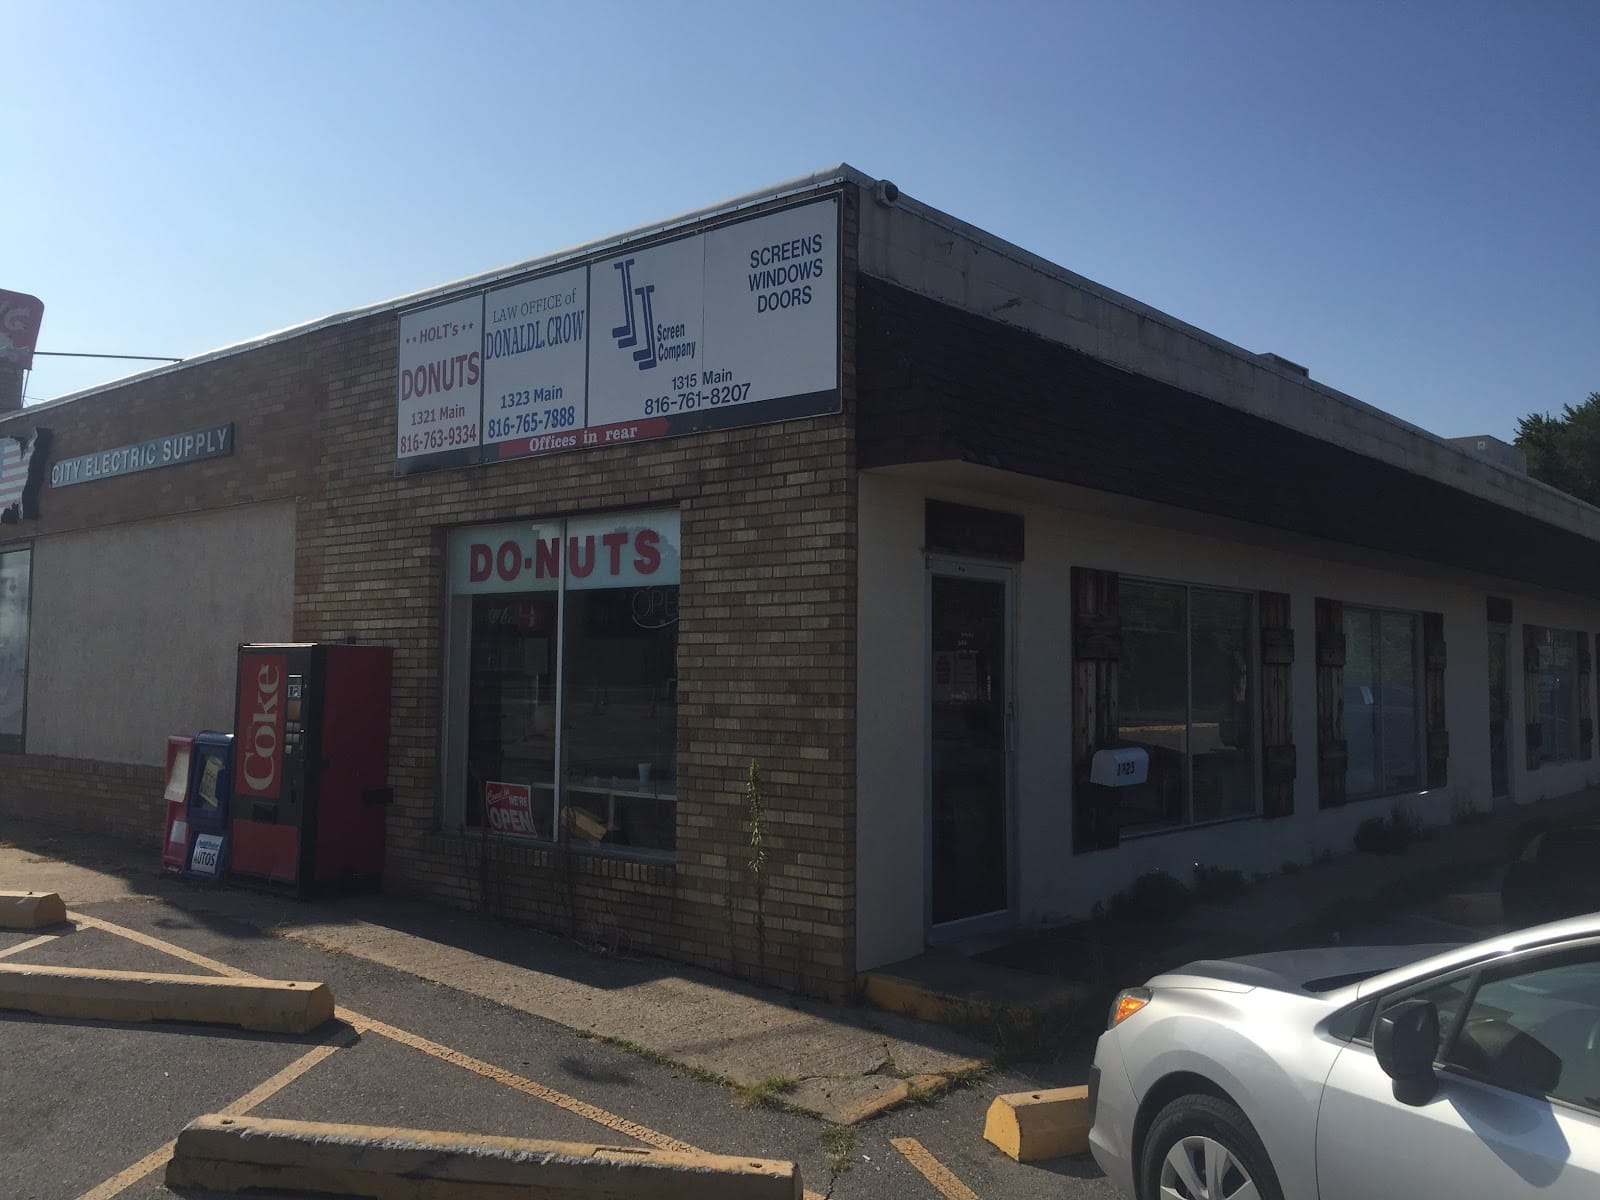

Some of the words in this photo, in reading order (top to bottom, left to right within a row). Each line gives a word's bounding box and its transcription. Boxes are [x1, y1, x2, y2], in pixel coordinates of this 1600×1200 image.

[750, 234, 822, 268] SCREENS
[748, 258, 823, 292] WINDOWS
[493, 305, 518, 323] LAW
[521, 294, 562, 316] OFFICE
[565, 288, 576, 305] of
[757, 285, 812, 313] DOORS
[420, 322, 459, 344] HOLT's
[547, 310, 585, 347] CROW
[657, 323, 685, 342] Screen
[658, 341, 696, 361] Company
[402, 351, 479, 401] DONUTS
[672, 373, 697, 390] 1315
[703, 368, 733, 385] Main
[501, 390, 530, 409] 1323
[534, 385, 563, 403] Main
[644, 383, 751, 415] 816-761-8207
[411, 408, 436, 426] 1321
[440, 403, 465, 420] Main
[488, 406, 575, 439] 816-765-7888
[400, 423, 476, 454] 816-763-9334
[529, 435, 576, 452] Offices
[583, 430, 597, 444] in
[605, 426, 638, 441] rear
[51, 460, 81, 484] CITY
[86, 444, 156, 477] ELECTRIC
[163, 428, 227, 461] SUPPLY
[243, 664, 279, 791] Coke
[489, 807, 534, 833] OPEN
[193, 851, 216, 866] AUTOS
